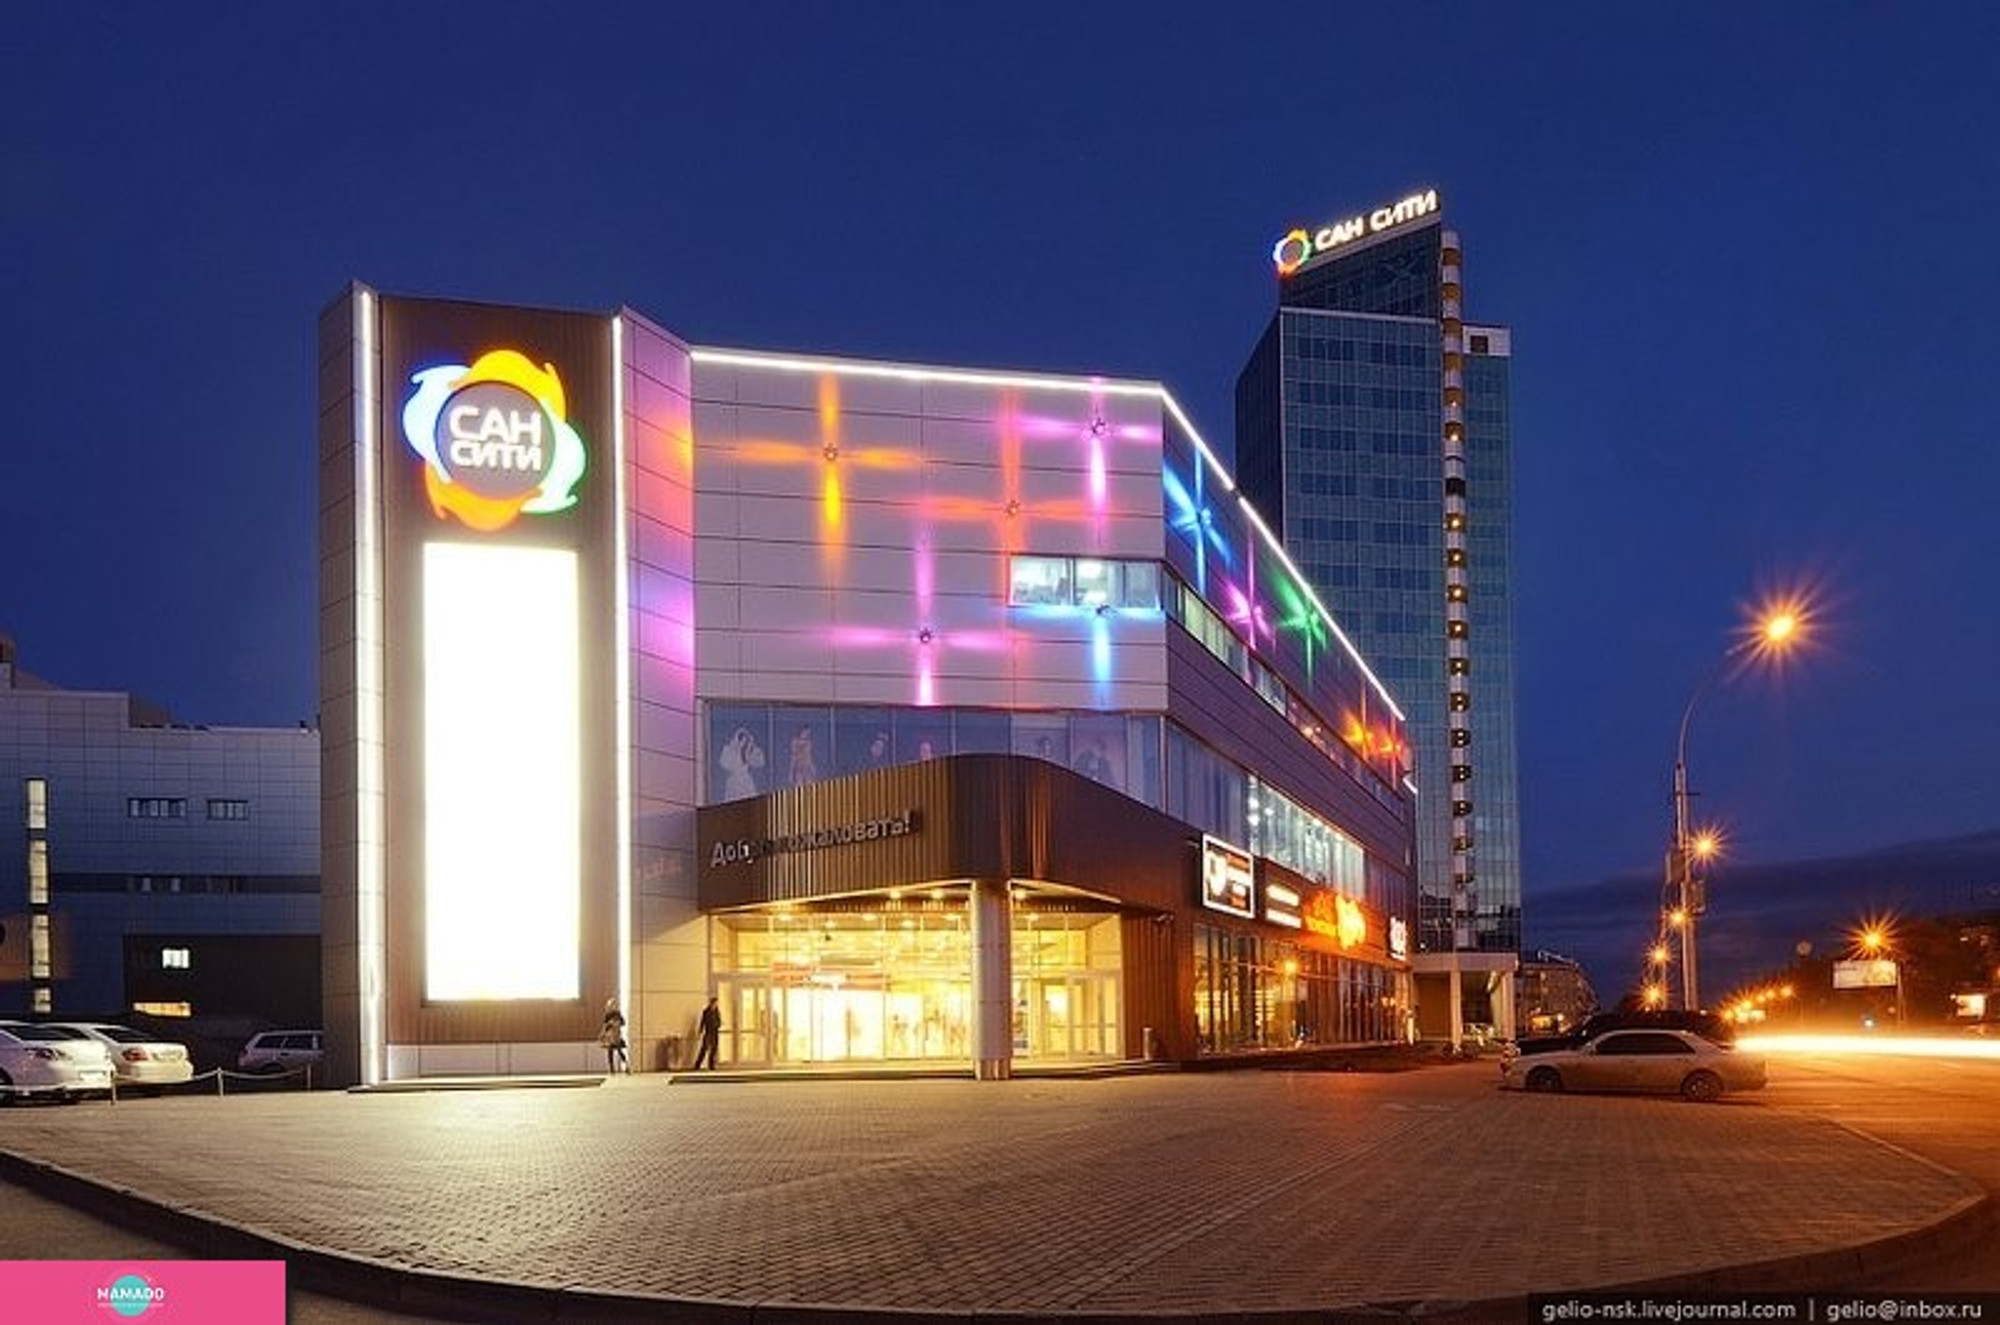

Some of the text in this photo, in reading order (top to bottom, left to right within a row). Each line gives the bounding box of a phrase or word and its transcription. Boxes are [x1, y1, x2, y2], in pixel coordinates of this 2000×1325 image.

[1315, 189, 1437, 250] САН СИТИ
[449, 404, 542, 445] САН
[450, 440, 542, 471] СИТИ
